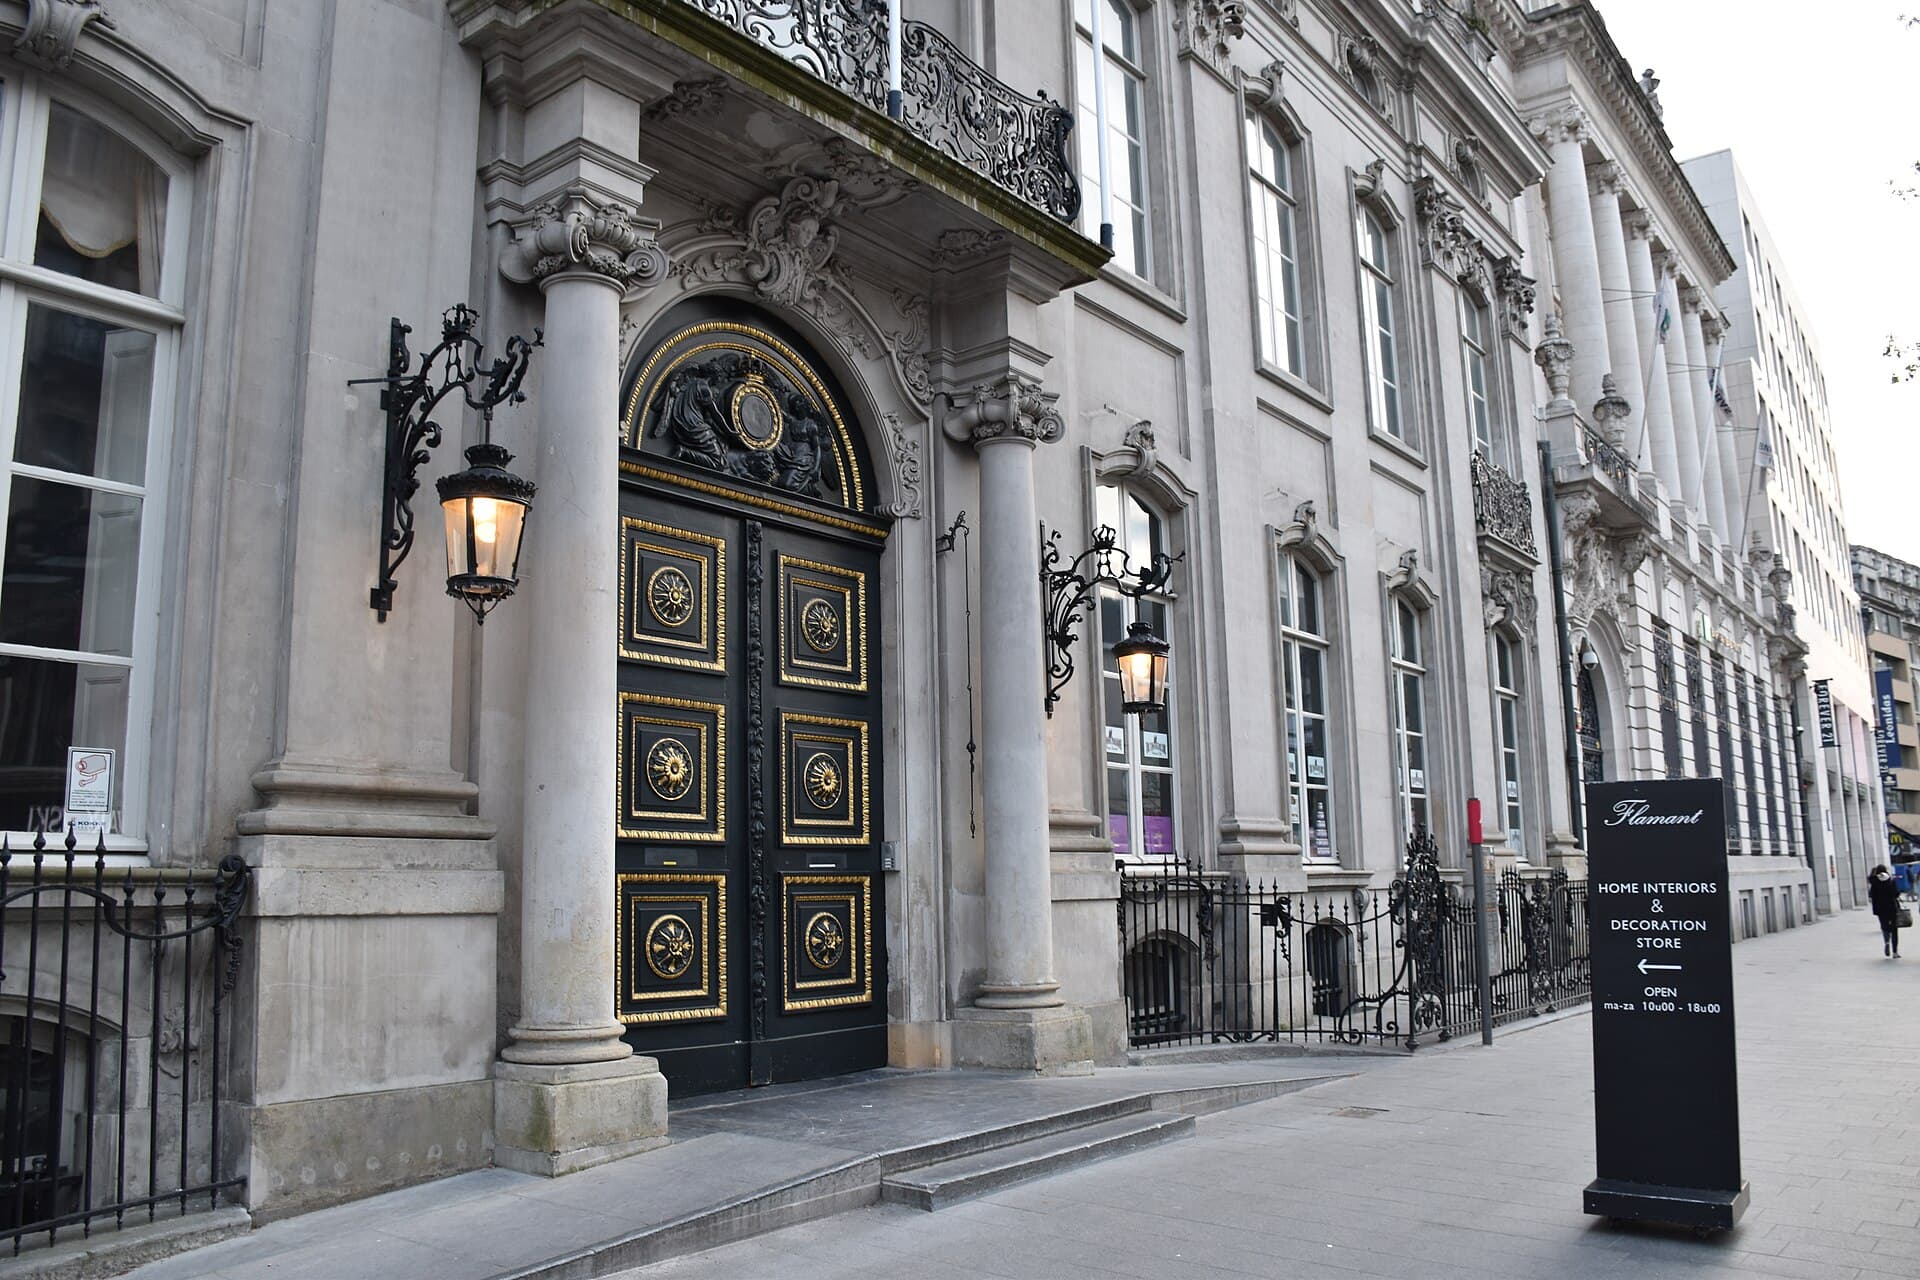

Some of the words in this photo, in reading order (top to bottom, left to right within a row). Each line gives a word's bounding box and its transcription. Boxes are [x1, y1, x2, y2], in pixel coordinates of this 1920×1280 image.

[1817, 684, 1831, 729] FOREVER
[1881, 694, 1896, 743] Leonidas
[1822, 733, 1834, 742] 21
[1603, 799, 1704, 826] Flamant
[1598, 882, 1639, 894] HOME
[1643, 882, 1717, 894] INTERIORS
[1650, 898, 1664, 913] &
[1610, 919, 1707, 931] DECORATION
[1636, 937, 1682, 949] STORE
[1644, 986, 1678, 998] OPEN
[1603, 1002, 1635, 1011] ma-za
[1642, 1001, 1675, 1012] 10u00
[1687, 1002, 1721, 1014] 18u00
